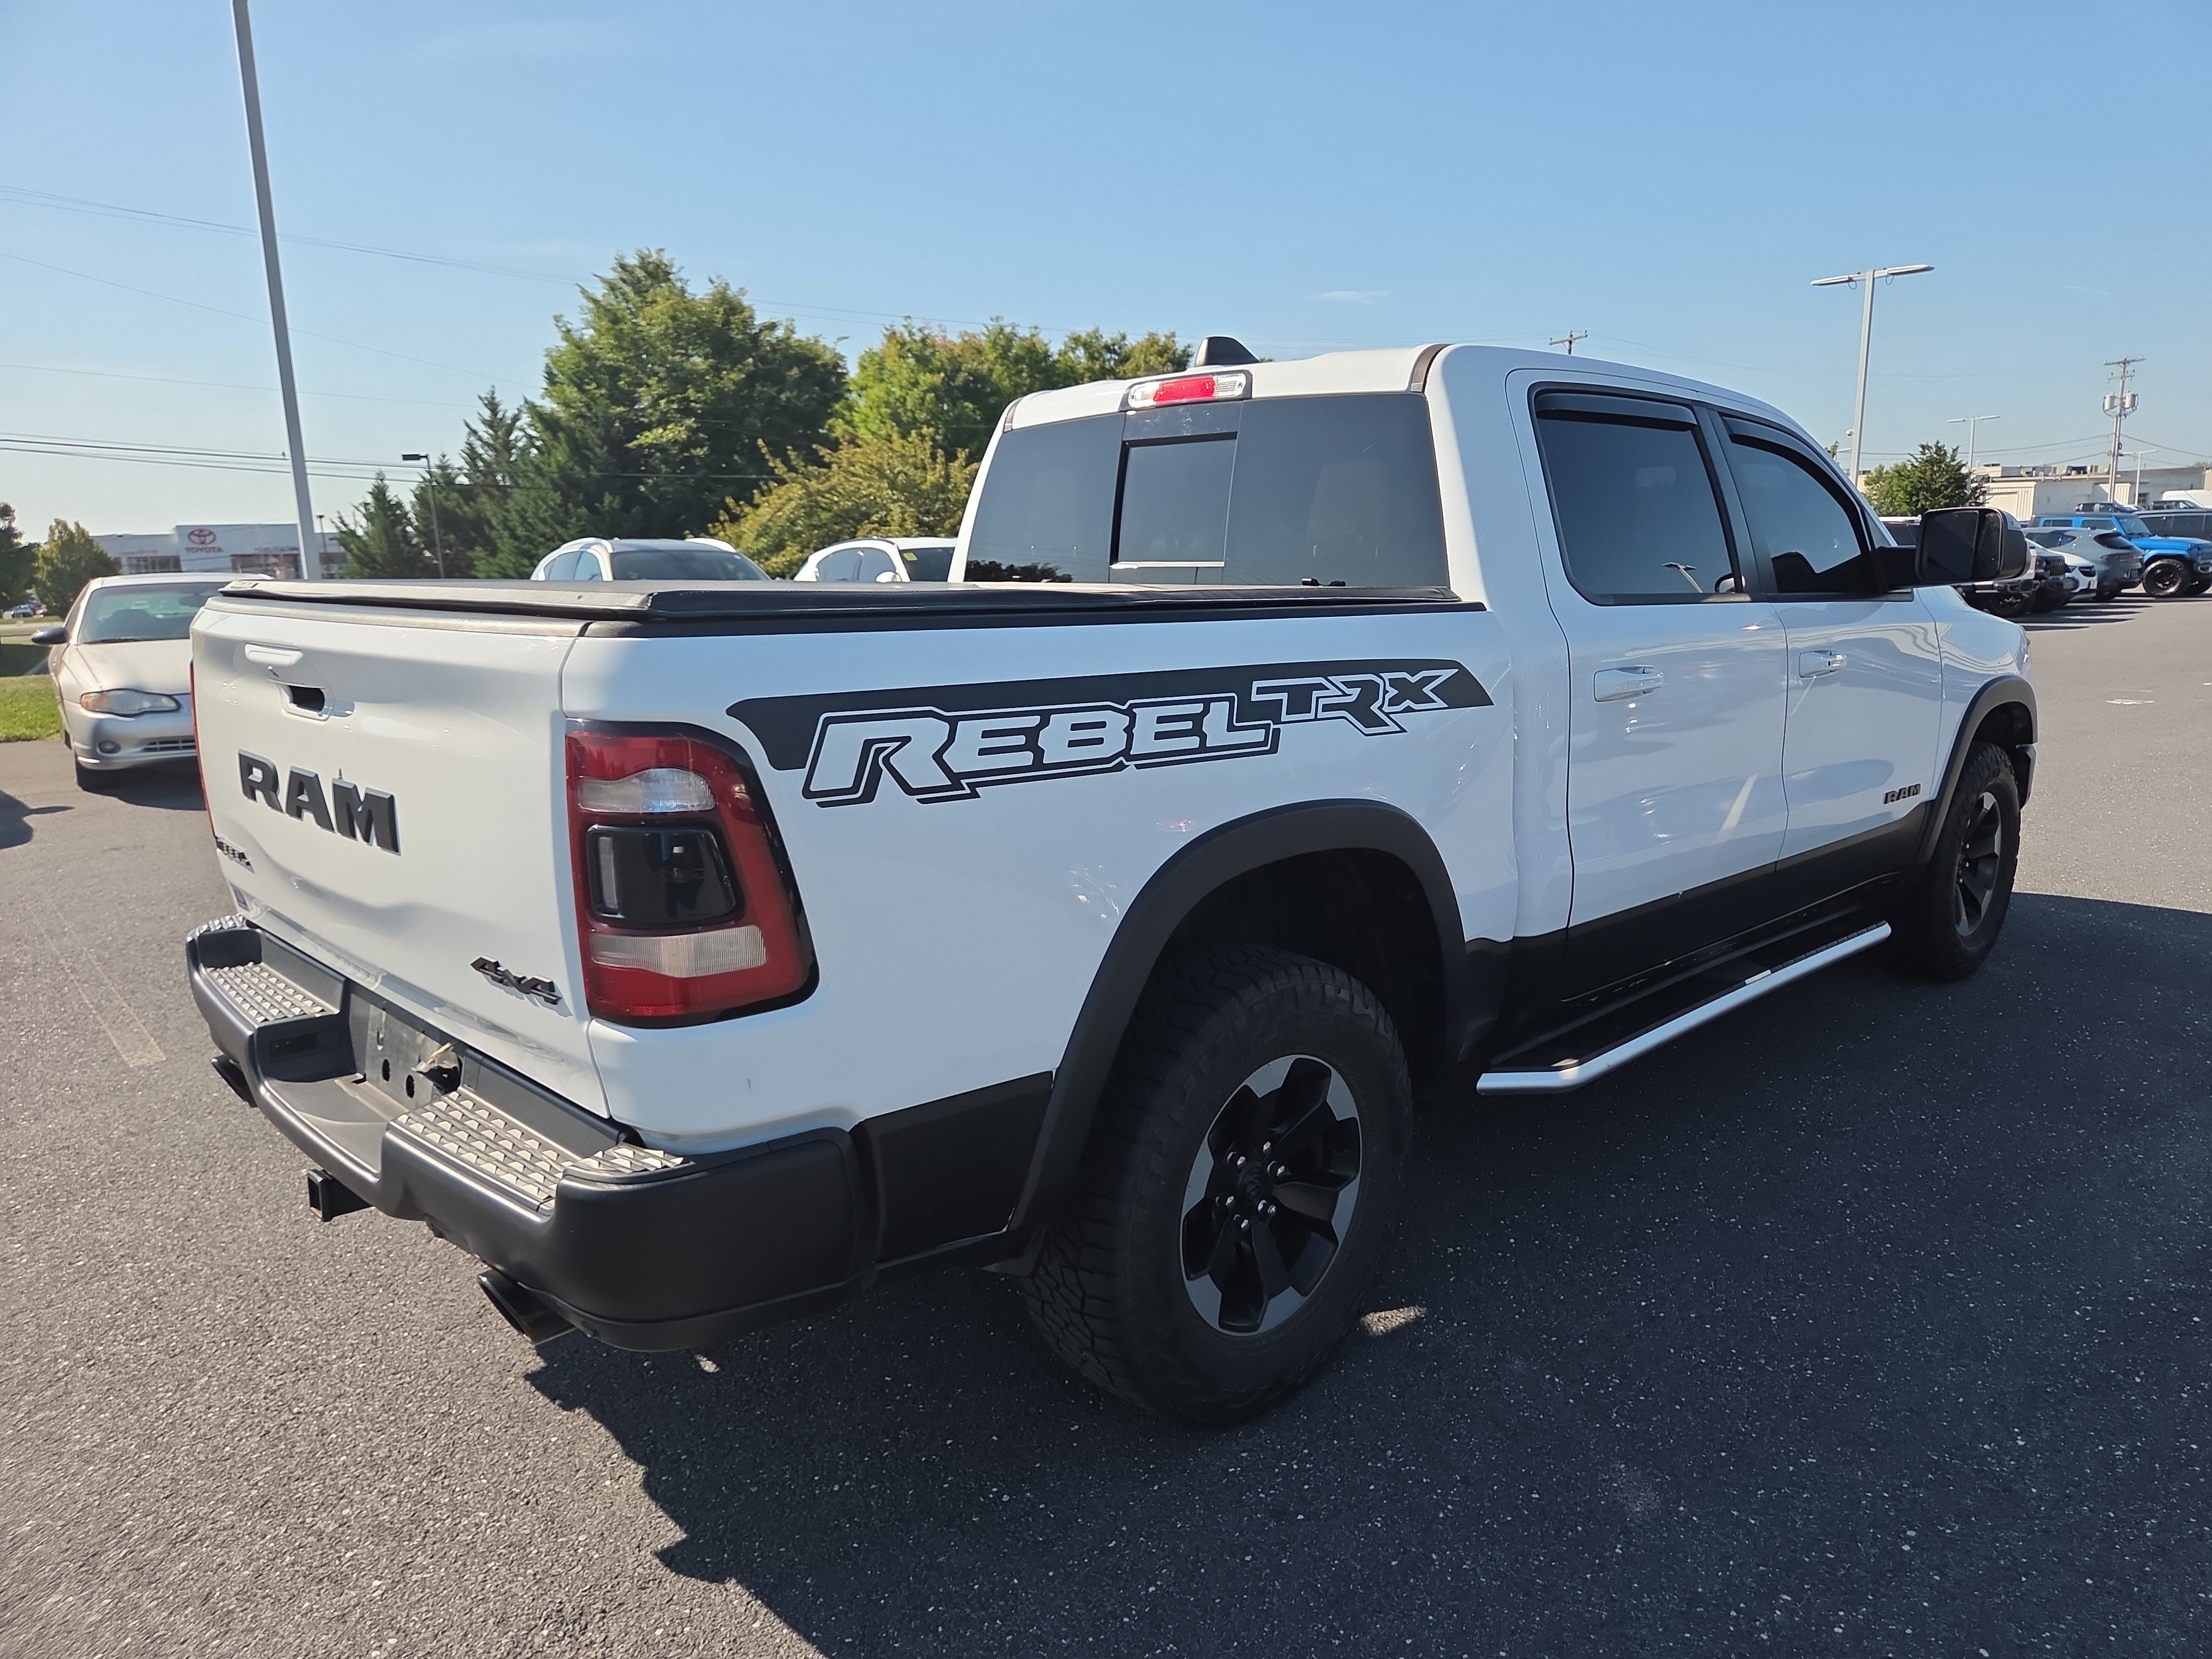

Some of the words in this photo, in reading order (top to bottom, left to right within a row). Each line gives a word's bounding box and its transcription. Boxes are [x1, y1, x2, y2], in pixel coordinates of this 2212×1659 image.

[802, 692, 1275, 803] REBEL
[1251, 669, 1459, 735] TRX
[239, 748, 402, 857] RAM
[1883, 783, 1921, 805] RAM
